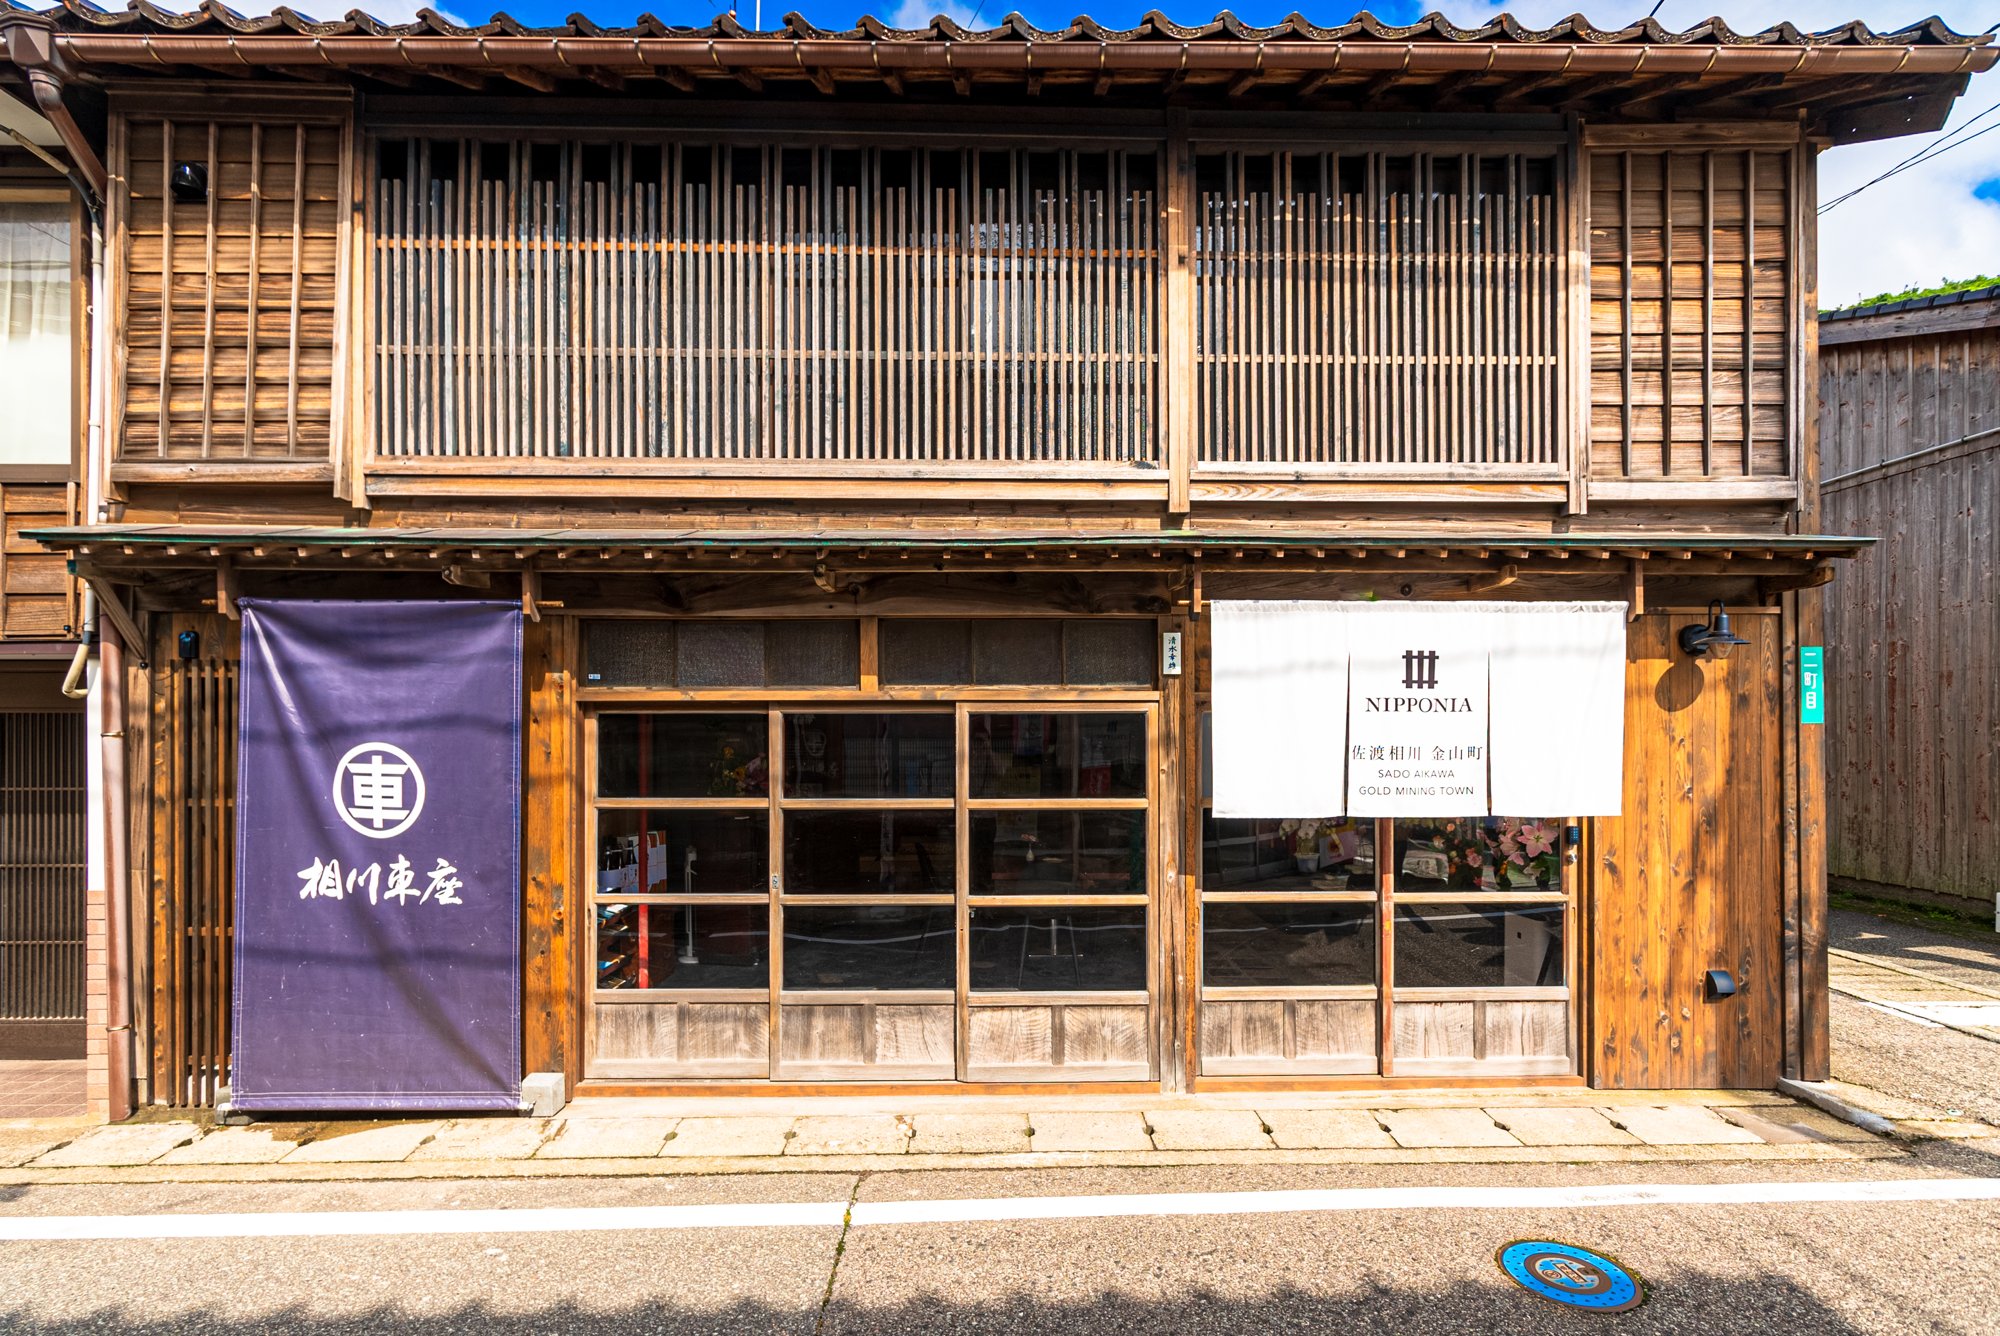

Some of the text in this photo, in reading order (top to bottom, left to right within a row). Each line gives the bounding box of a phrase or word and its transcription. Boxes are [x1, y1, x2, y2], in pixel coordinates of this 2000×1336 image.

[1803, 652, 1818, 710] 二町目
[1365, 697, 1473, 713] NIPPONIA
[1352, 745, 1483, 761] 佐渡相川 金山町
[1378, 769, 1455, 778] SADO AIKAWA
[346, 755, 410, 829] 車
[1359, 786, 1474, 796] GOLD MINING TOWN
[296, 853, 463, 906] 相川車座
